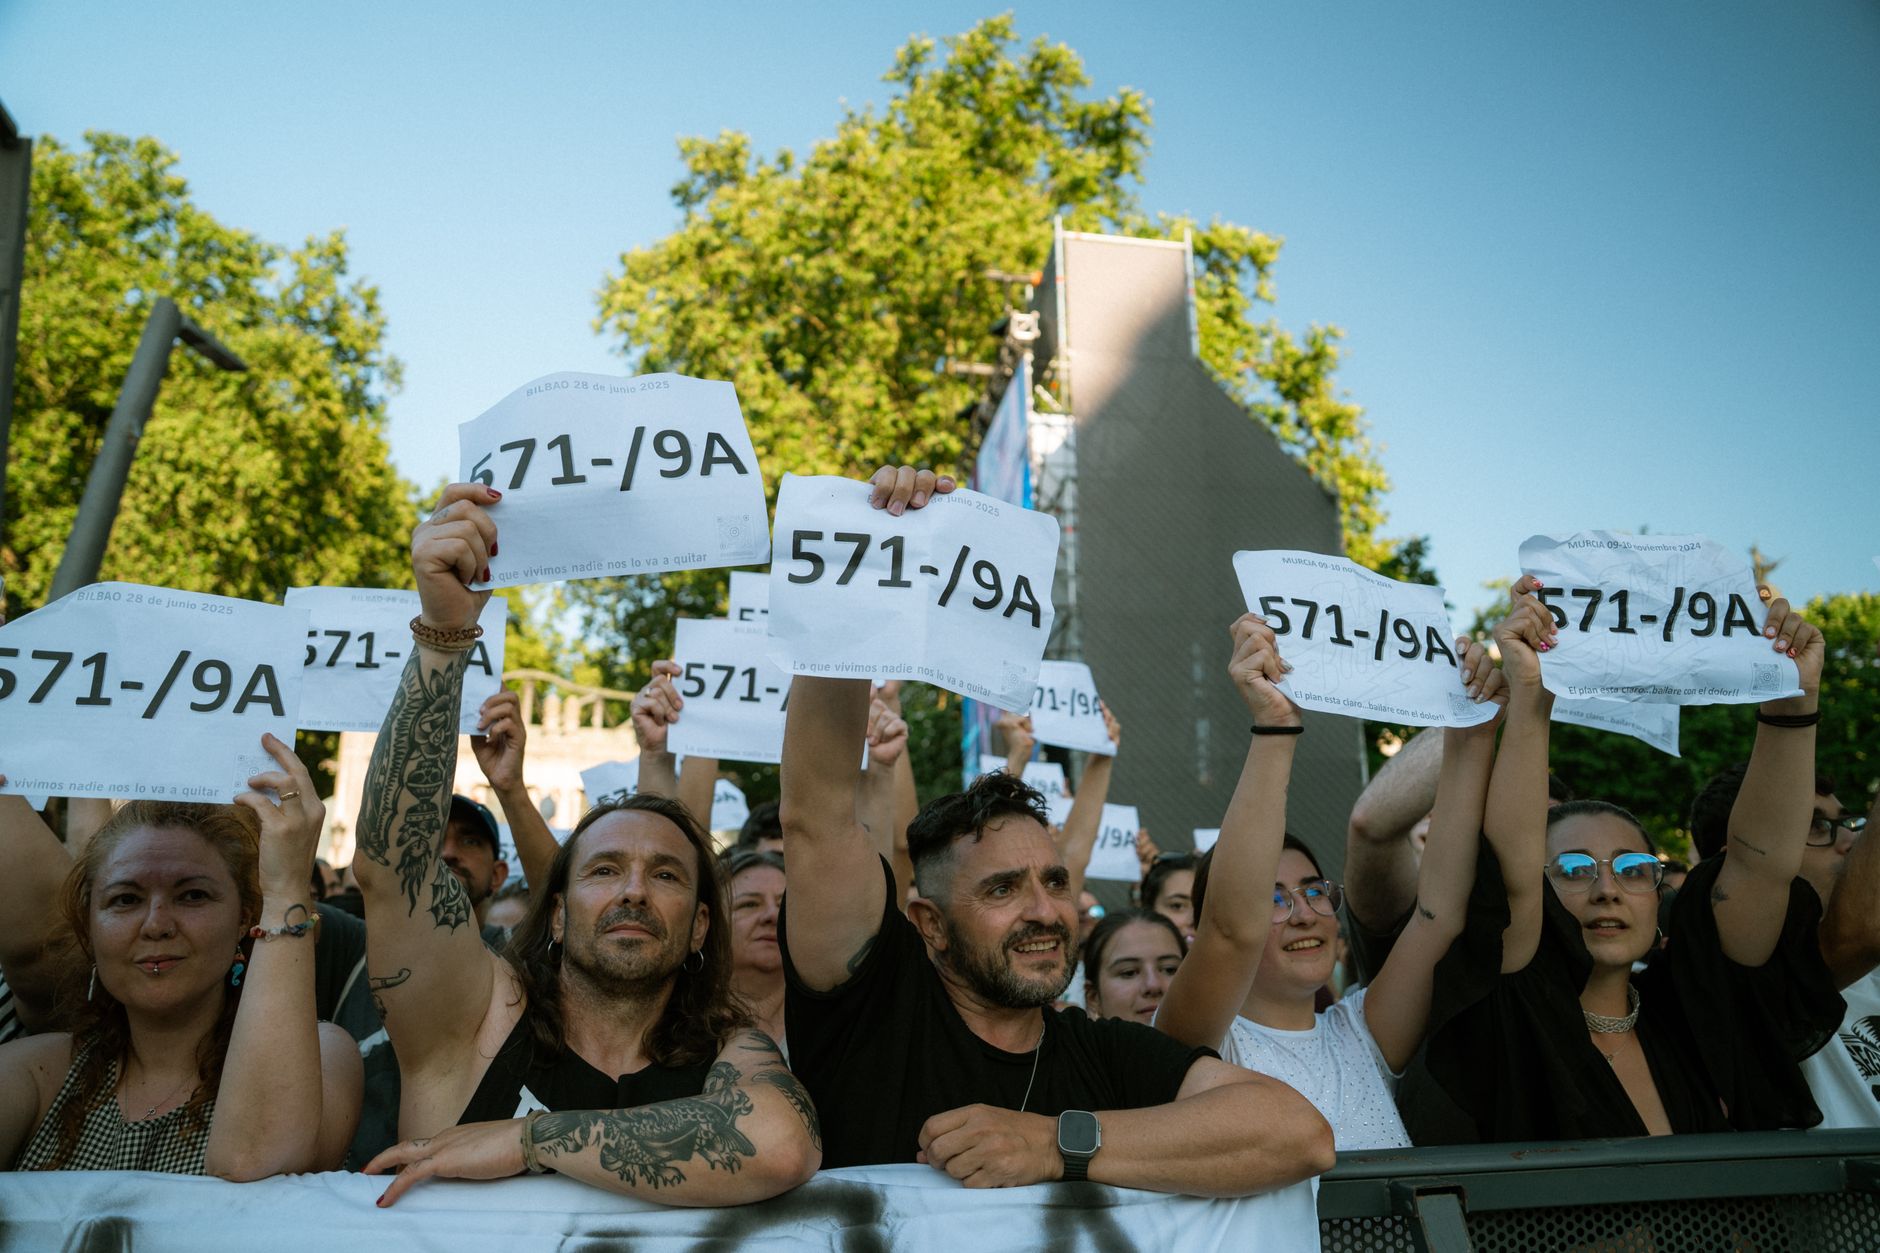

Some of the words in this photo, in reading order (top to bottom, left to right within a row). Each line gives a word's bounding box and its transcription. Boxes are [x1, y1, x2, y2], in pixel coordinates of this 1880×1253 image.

[526, 380, 569, 397] BILBAO
[574, 380, 589, 390] 28
[592, 382, 606, 392] de
[609, 383, 636, 395] junio
[639, 380, 670, 392] 2025
[975, 501, 1000, 518] 2025
[1567, 539, 1605, 549] MURCIA
[1606, 540, 1633, 549] 09-10
[1678, 542, 1702, 552] 2024
[499, 570, 519, 583] que
[523, 565, 567, 578] vivimos
[571, 558, 603, 572] nadie
[607, 559, 627, 570] nos
[631, 557, 641, 568] lo
[646, 558, 658, 566] va
[663, 557, 669, 566] a
[674, 553, 707, 566] quitar
[1281, 557, 1318, 568] MURCIA
[788, 530, 1041, 629] 571-/9A
[77, 591, 122, 602] BILBAO
[126, 592, 144, 604] 28
[147, 595, 162, 606] de
[166, 598, 197, 610] junio
[201, 602, 233, 615] 2025
[1537, 587, 1762, 642] 571-/9A
[1258, 596, 1457, 668] 571-/9A
[792, 660, 806, 671] Lo
[810, 662, 831, 674] que
[835, 662, 877, 673] vivimos
[881, 662, 913, 674] nadie
[917, 664, 934, 677] nos
[936, 669, 945, 681] lo
[946, 674, 957, 685] va
[958, 680, 964, 688] a
[966, 681, 992, 697] quitar
[1568, 686, 1577, 695] El
[1578, 686, 1598, 696] plan
[1683, 688, 1696, 696] con
[1698, 687, 1707, 696] el
[1294, 691, 1303, 699] El
[1305, 692, 1323, 702] plan
[1324, 695, 1341, 705] esta
[1395, 707, 1410, 716] con
[1411, 709, 1419, 718] el
[14, 778, 64, 790] vivimos
[69, 780, 104, 792] nadie
[108, 783, 130, 793] nos
[135, 782, 146, 793] lo
[151, 785, 165, 794] va
[170, 786, 177, 795] a
[182, 786, 219, 798] quitar
